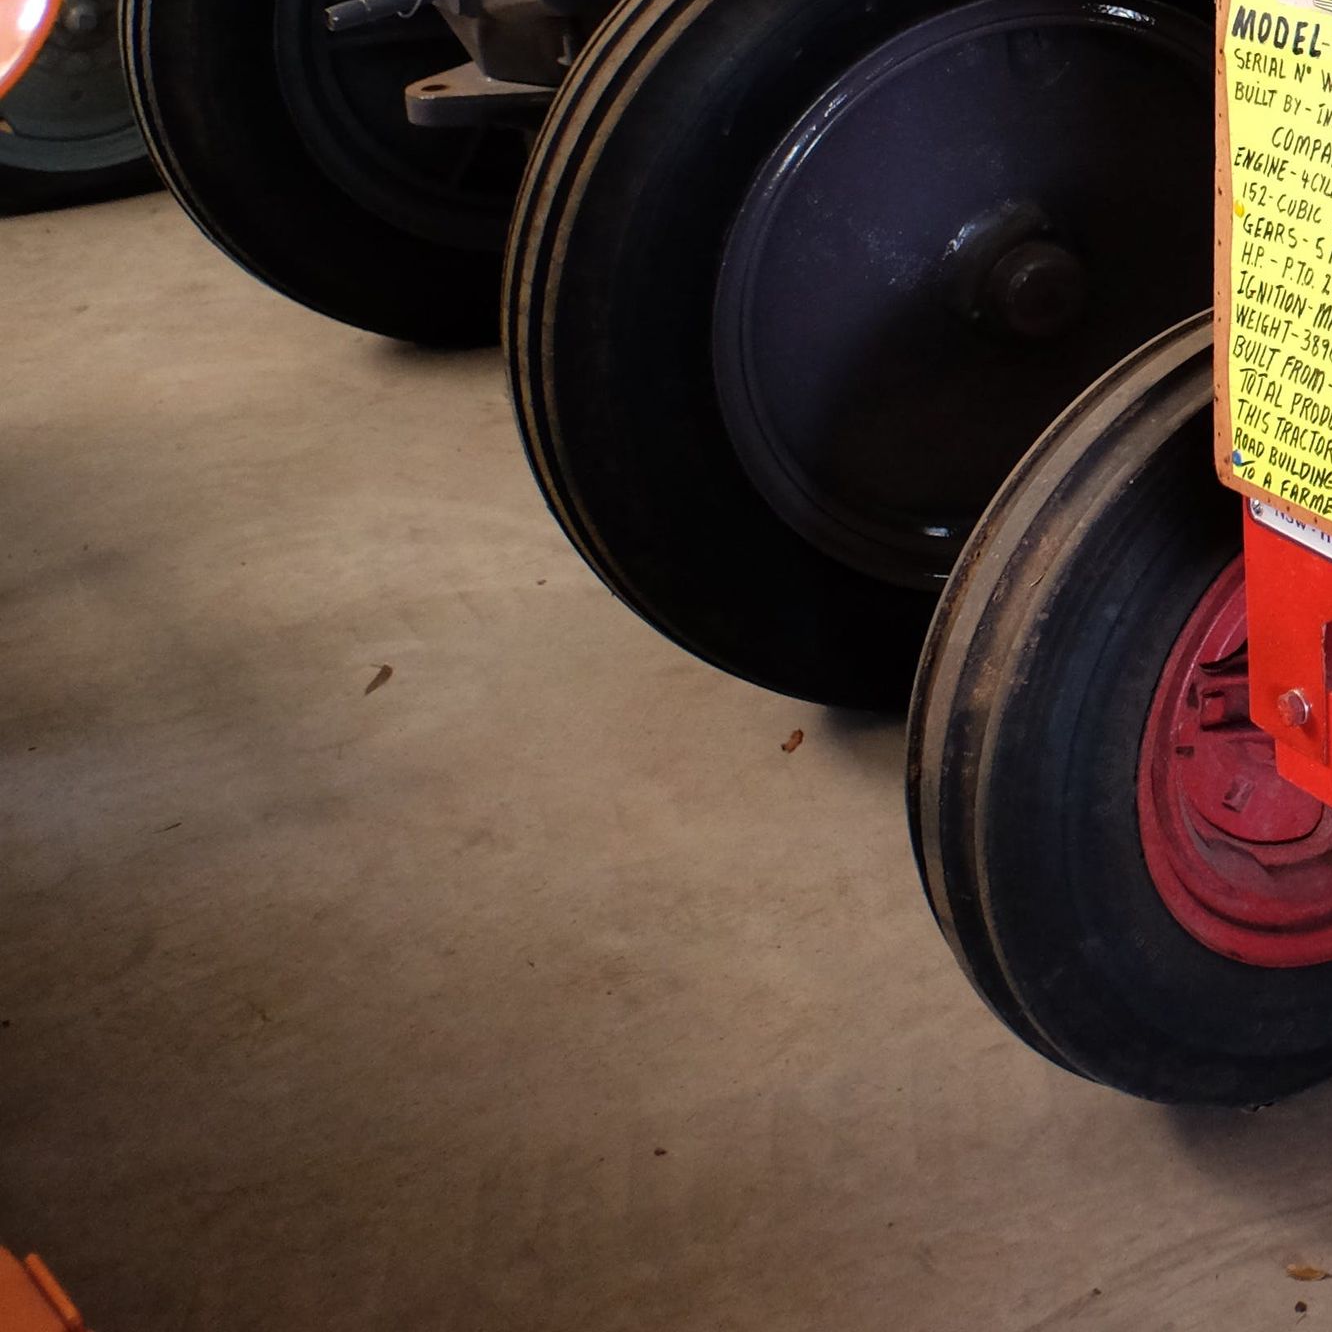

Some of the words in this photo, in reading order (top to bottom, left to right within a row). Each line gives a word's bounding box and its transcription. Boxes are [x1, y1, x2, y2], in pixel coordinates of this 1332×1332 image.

[1234, 48, 1286, 79] SERIAL
[1232, 334, 1282, 371] BUILT
[1239, 367, 1283, 409] TOTAL
[1237, 398, 1271, 435] THIS
[1233, 426, 1265, 459] ROAD
[1240, 460, 1256, 480] TO
[1262, 471, 1273, 490] A
